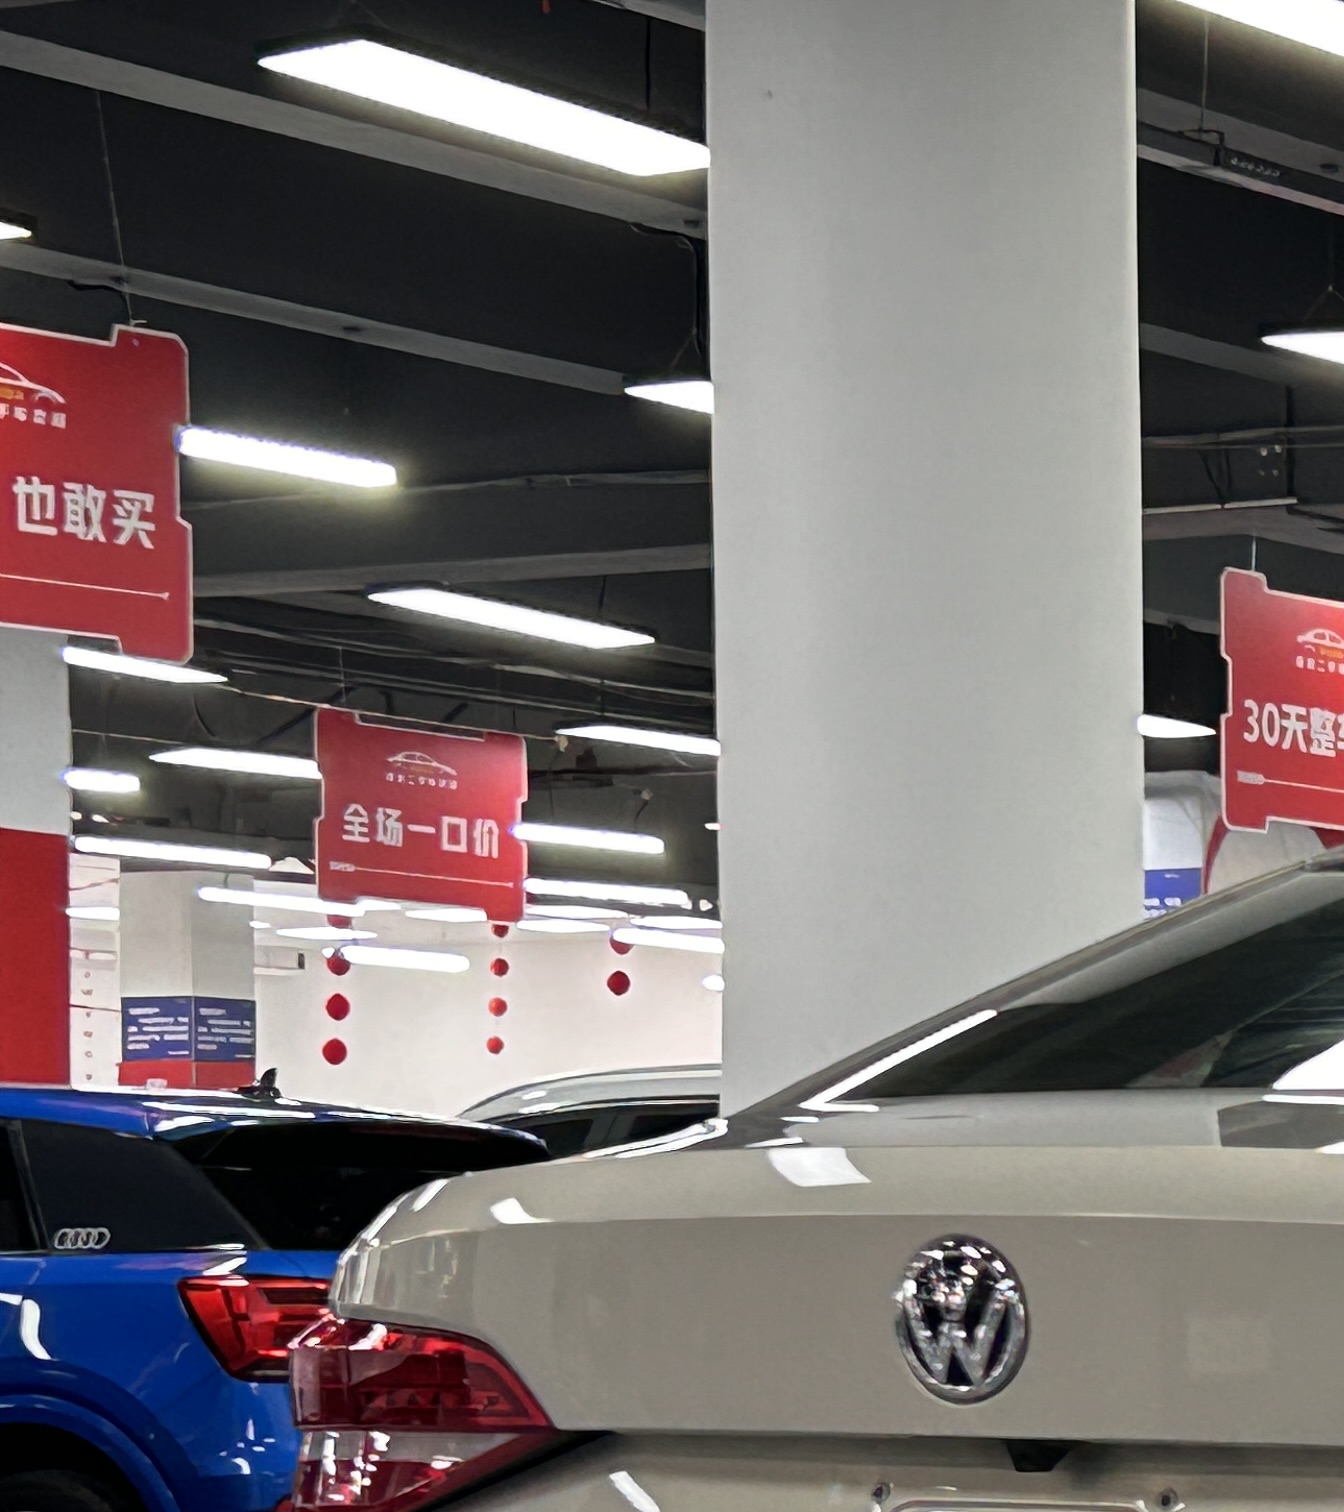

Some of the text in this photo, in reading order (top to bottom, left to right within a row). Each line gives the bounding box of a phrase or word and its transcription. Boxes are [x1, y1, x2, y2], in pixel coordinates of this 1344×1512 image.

[12, 476, 155, 549] 也敢买
[342, 803, 499, 859] 全场一口价
